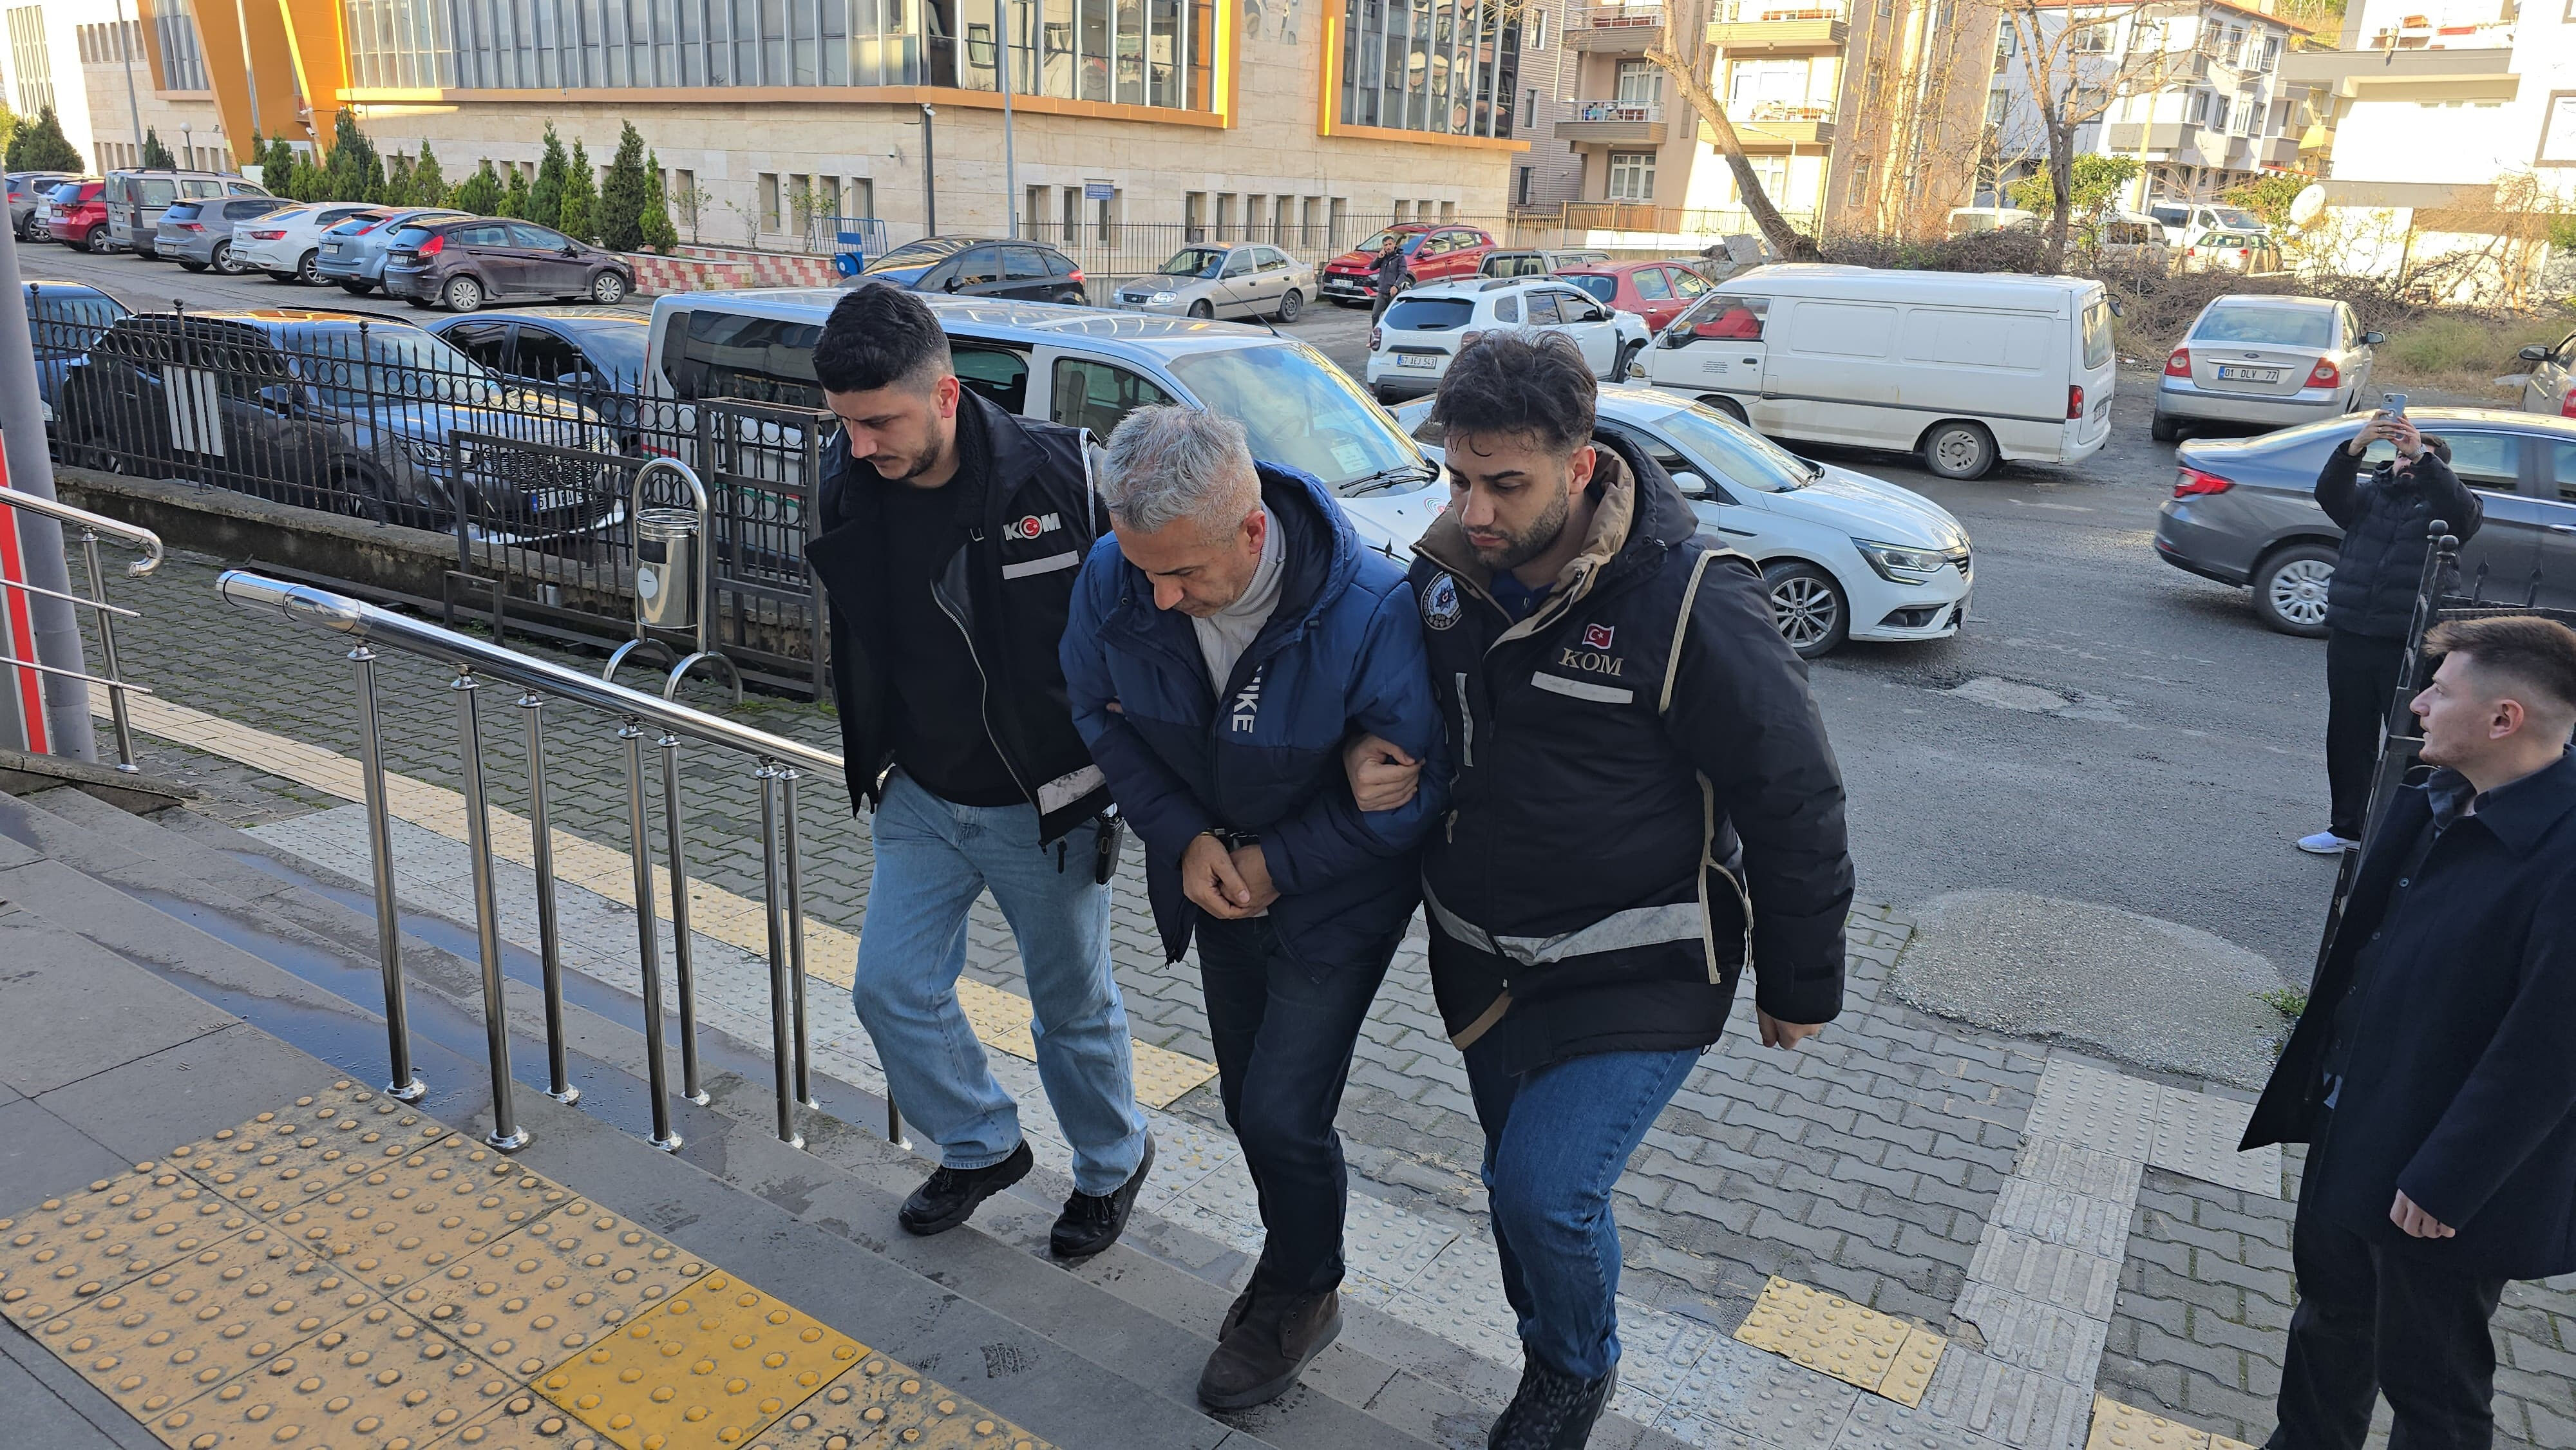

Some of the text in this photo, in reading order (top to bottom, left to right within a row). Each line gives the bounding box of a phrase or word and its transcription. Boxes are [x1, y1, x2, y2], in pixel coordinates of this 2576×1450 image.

[1423, 358, 1435, 366] 543
[2224, 368, 2233, 377] 01
[2266, 371, 2277, 380] 77
[1003, 512, 1061, 541] KOM
[1558, 647, 1624, 677] KOM
[1232, 665, 1262, 733] IKE
